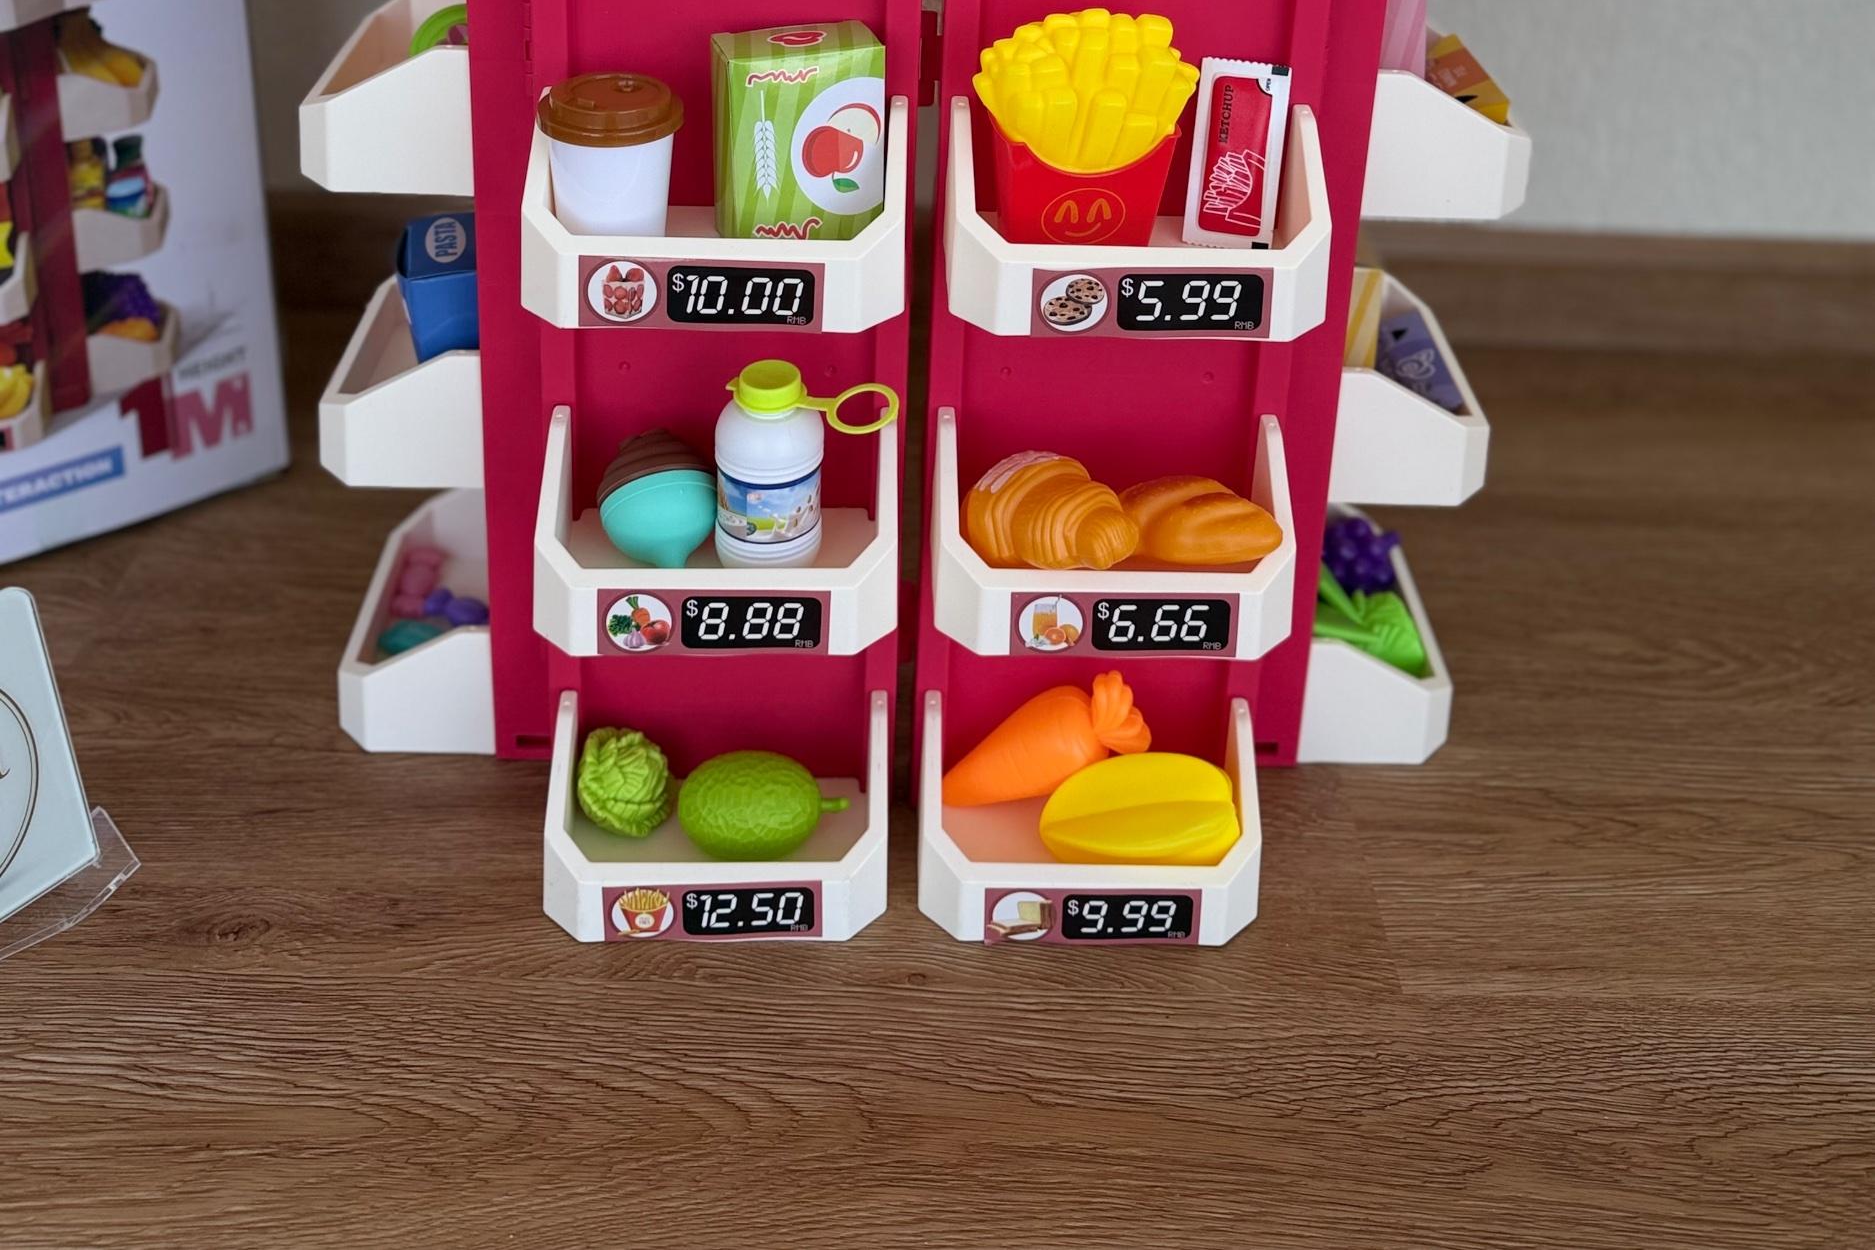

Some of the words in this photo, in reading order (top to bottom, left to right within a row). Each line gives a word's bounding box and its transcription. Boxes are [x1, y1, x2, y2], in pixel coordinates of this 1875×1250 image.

[1219, 84, 1234, 144] KETCHUP
[434, 221, 458, 258] PASTA
[671, 273, 804, 316] $10.00
[1121, 279, 1243, 321] $5.99
[786, 315, 807, 326] RMB
[1234, 321, 1254, 330] RMB
[118, 369, 254, 461] 1M
[0, 457, 114, 501] ERACTION
[686, 599, 805, 640] $8.88
[1097, 602, 1210, 643] $6.66
[794, 639, 814, 648] RMB
[1202, 641, 1222, 650] RMB
[686, 892, 804, 929] $12.50
[1067, 899, 1177, 933] $9.99
